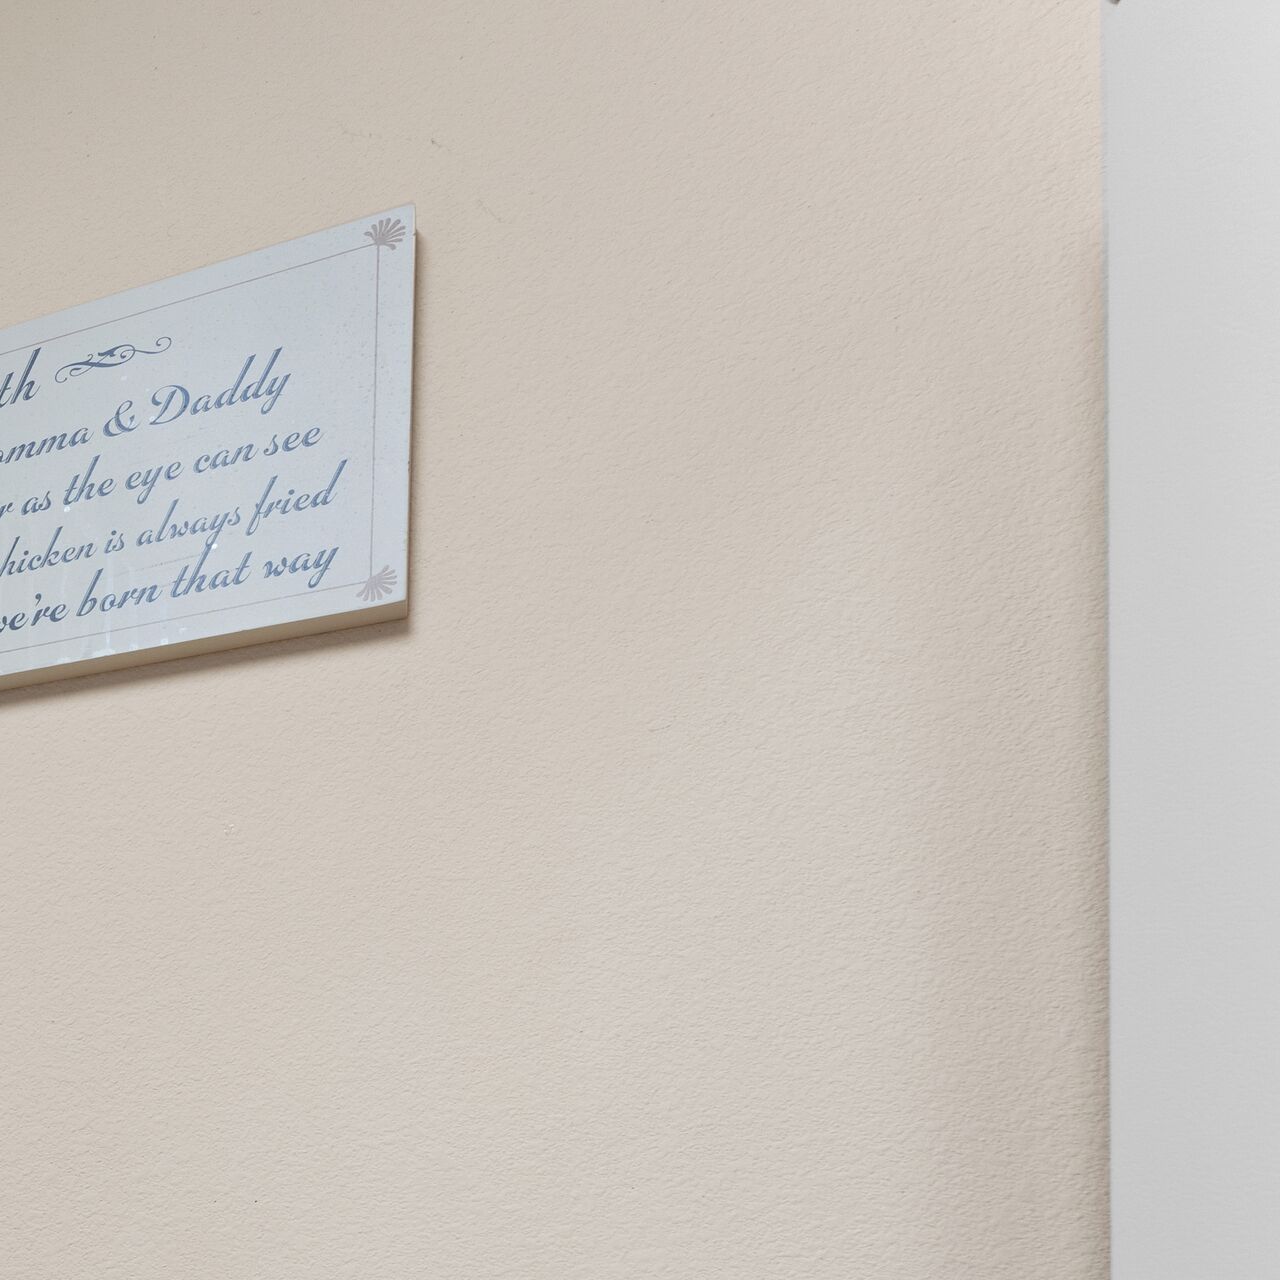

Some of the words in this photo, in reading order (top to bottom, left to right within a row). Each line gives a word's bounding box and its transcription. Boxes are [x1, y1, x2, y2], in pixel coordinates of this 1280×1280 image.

[103, 400, 140, 437] &
[149, 347, 291, 426] Daddy
[20, 490, 52, 515] as
[64, 454, 116, 505] the
[125, 461, 185, 505] eye
[193, 443, 260, 474] can
[263, 427, 324, 456] see
[103, 530, 125, 554] is
[136, 499, 241, 552] always
[246, 459, 348, 536] fried
[76, 568, 163, 617] born
[170, 545, 253, 598] that
[263, 547, 339, 588] way
